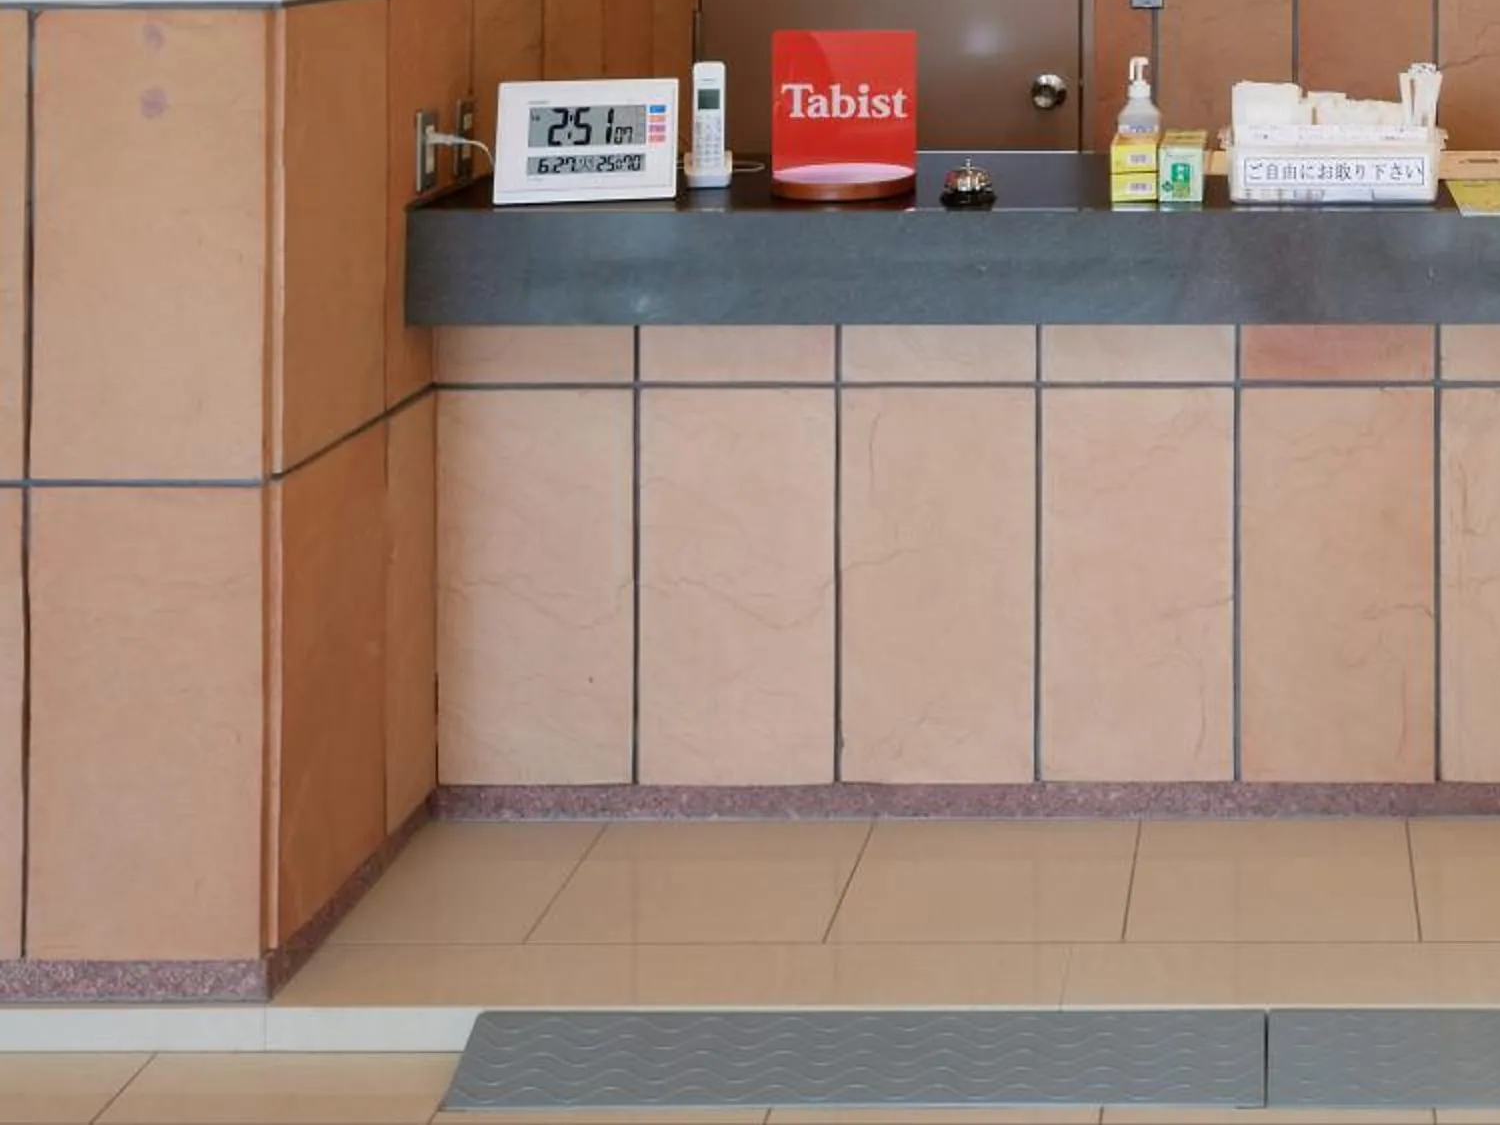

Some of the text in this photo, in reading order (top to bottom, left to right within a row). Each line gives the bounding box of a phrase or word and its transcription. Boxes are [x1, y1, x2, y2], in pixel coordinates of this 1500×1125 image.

[780, 82, 909, 119] Tabist
[547, 106, 615, 146] 2:51
[1249, 161, 1424, 181] ご自由にお取り下さい
